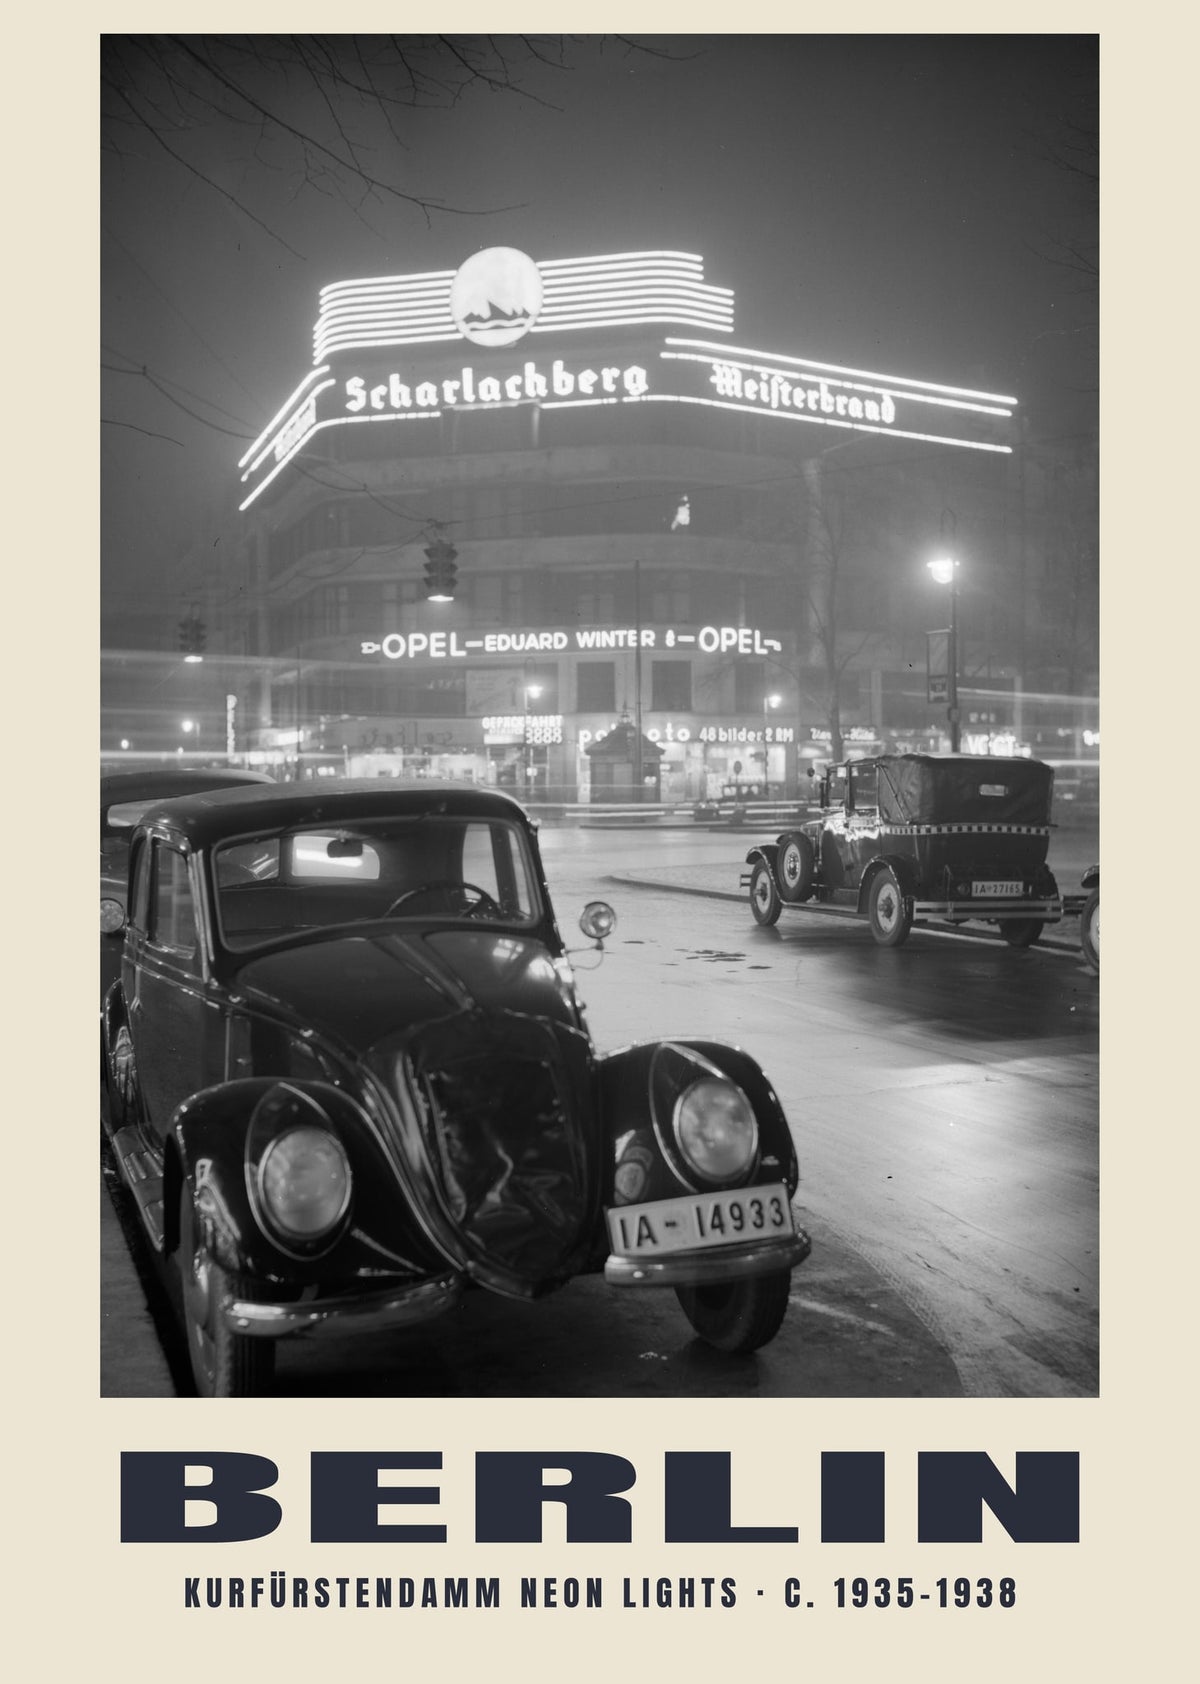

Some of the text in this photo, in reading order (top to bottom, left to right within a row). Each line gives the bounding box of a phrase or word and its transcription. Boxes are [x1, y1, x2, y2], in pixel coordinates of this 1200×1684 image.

[345, 360, 649, 411] Scharlachberg
[382, 632, 467, 659] OPEL
[484, 632, 568, 652] EDUARD
[576, 629, 656, 649] WINTER
[699, 626, 769, 654] OPEL
[699, 727, 717, 742] 48
